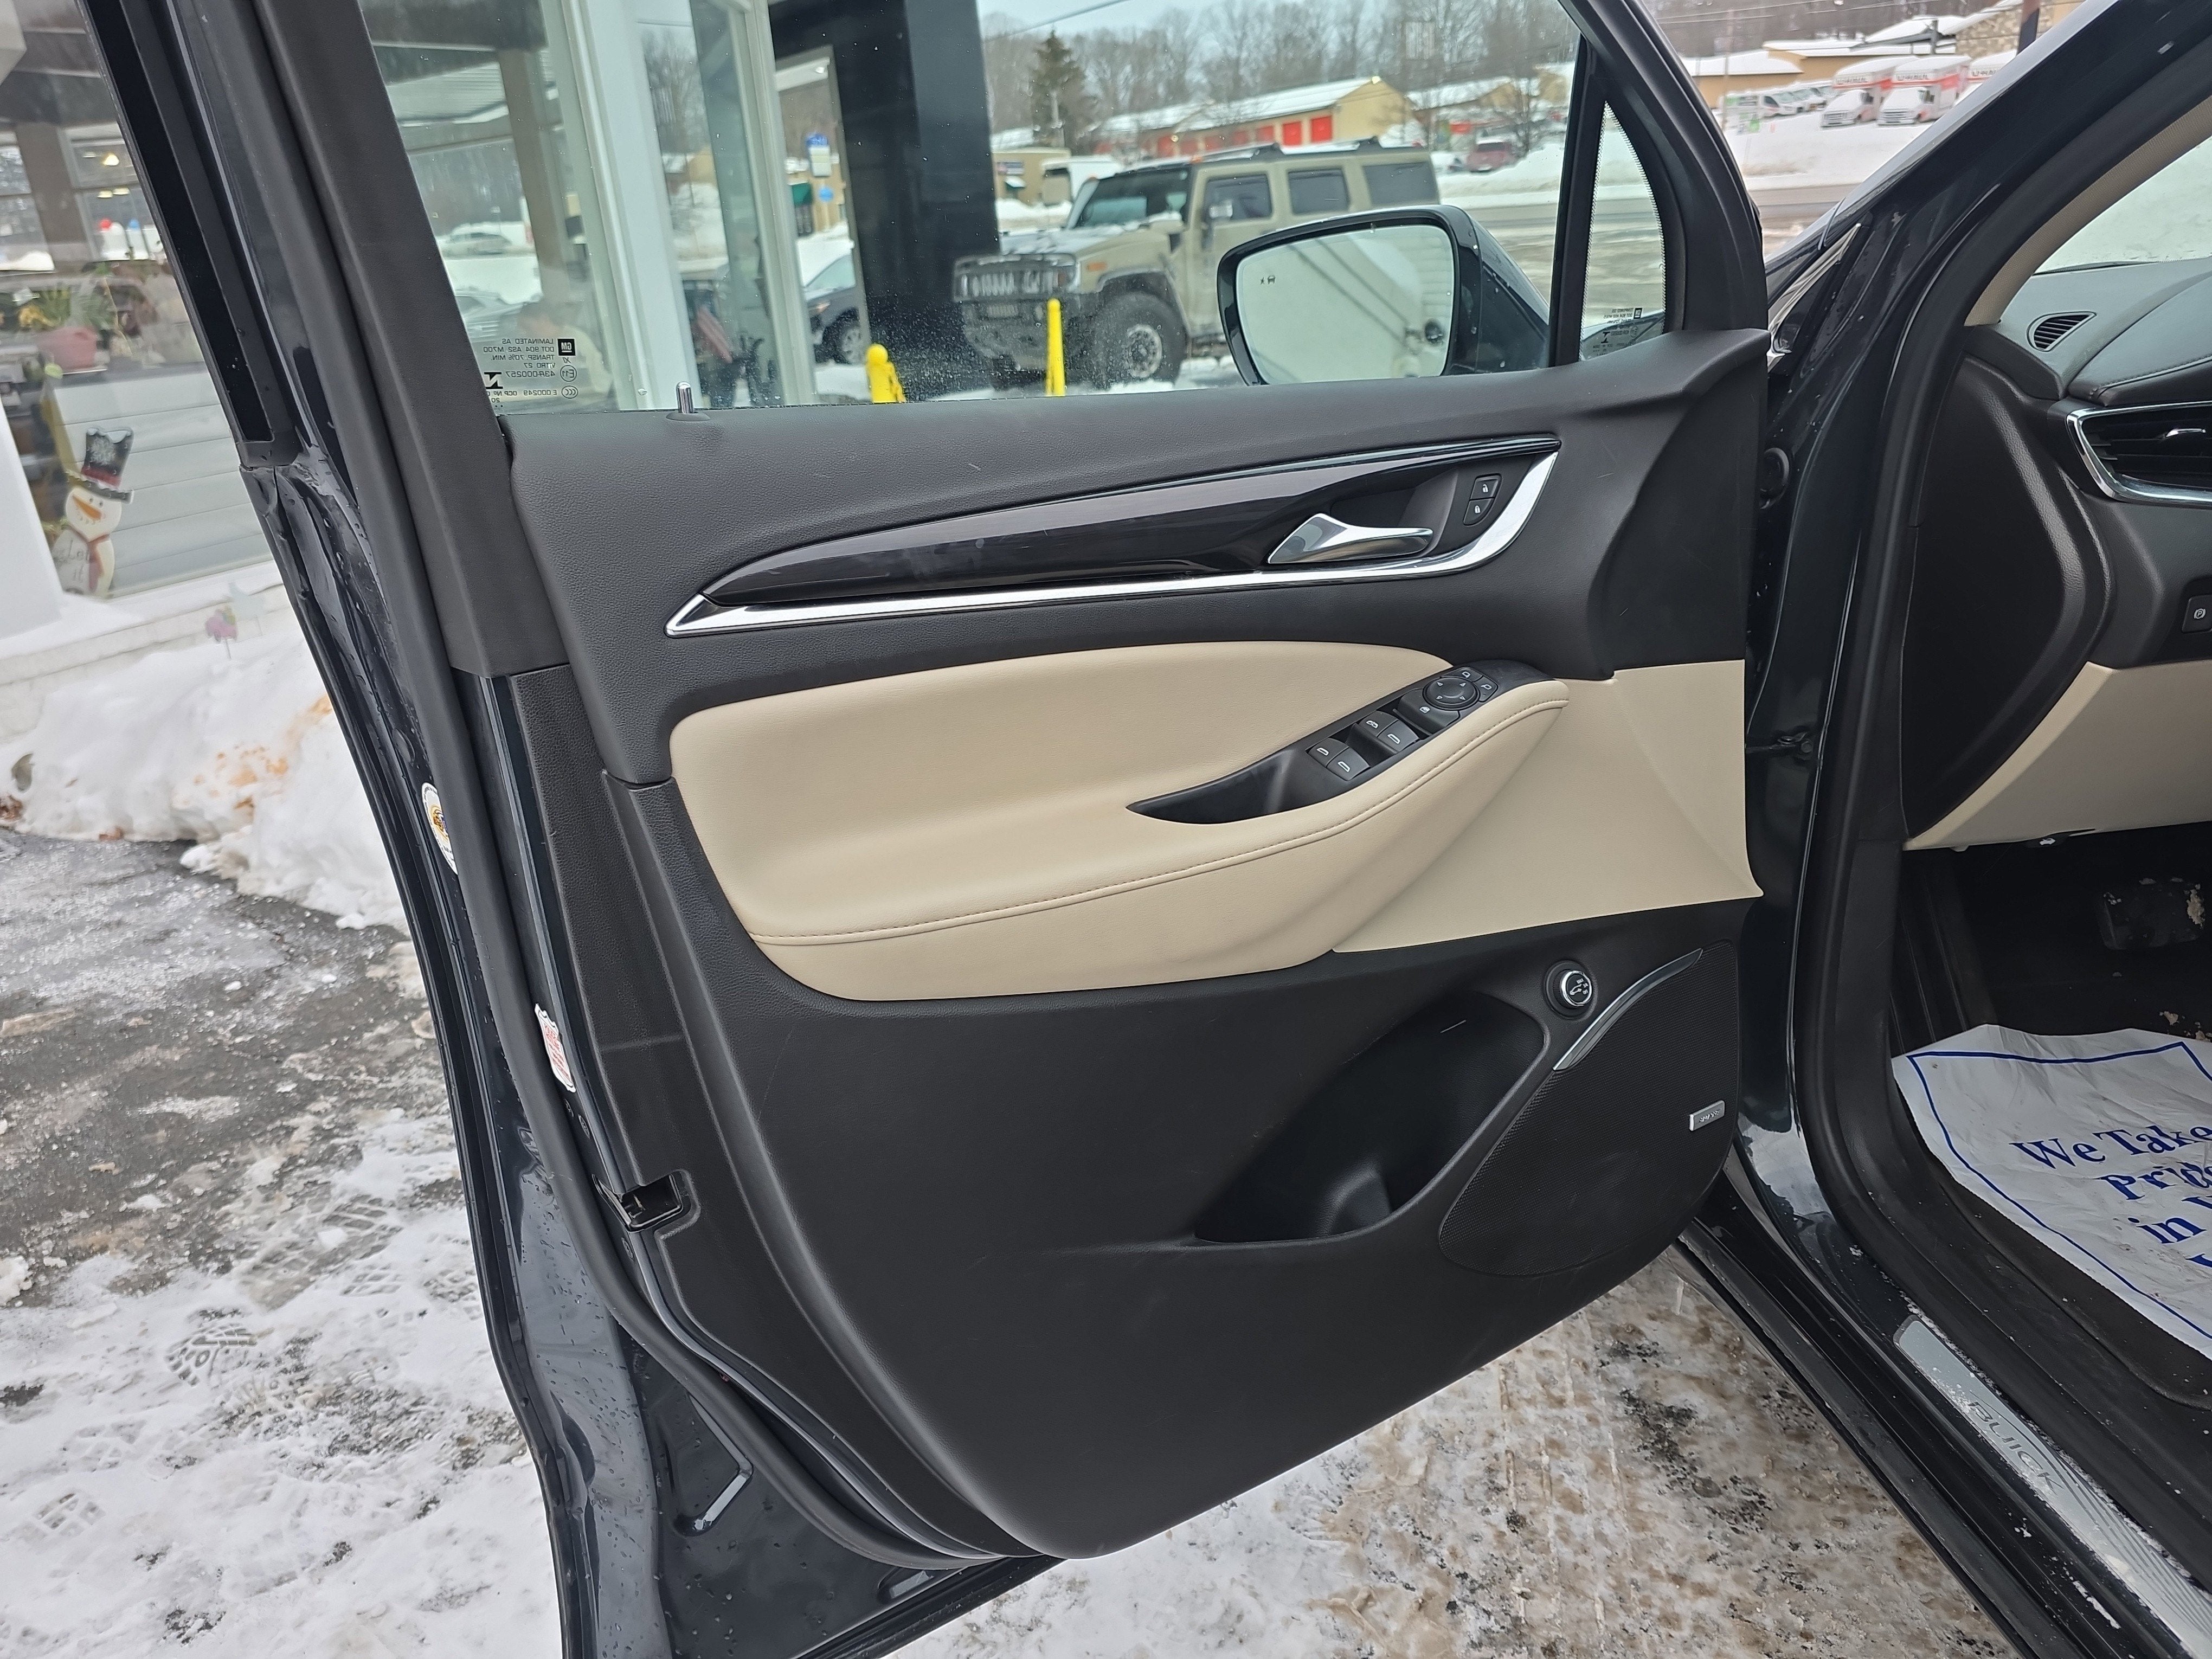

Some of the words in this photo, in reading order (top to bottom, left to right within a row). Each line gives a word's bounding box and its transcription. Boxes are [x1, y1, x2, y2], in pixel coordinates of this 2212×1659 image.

[2008, 1138, 2106, 1169] We
[2093, 1161, 2212, 1200] Prid
[2127, 1217, 2207, 1244] in
[1967, 1401, 2065, 1496] BUICK
